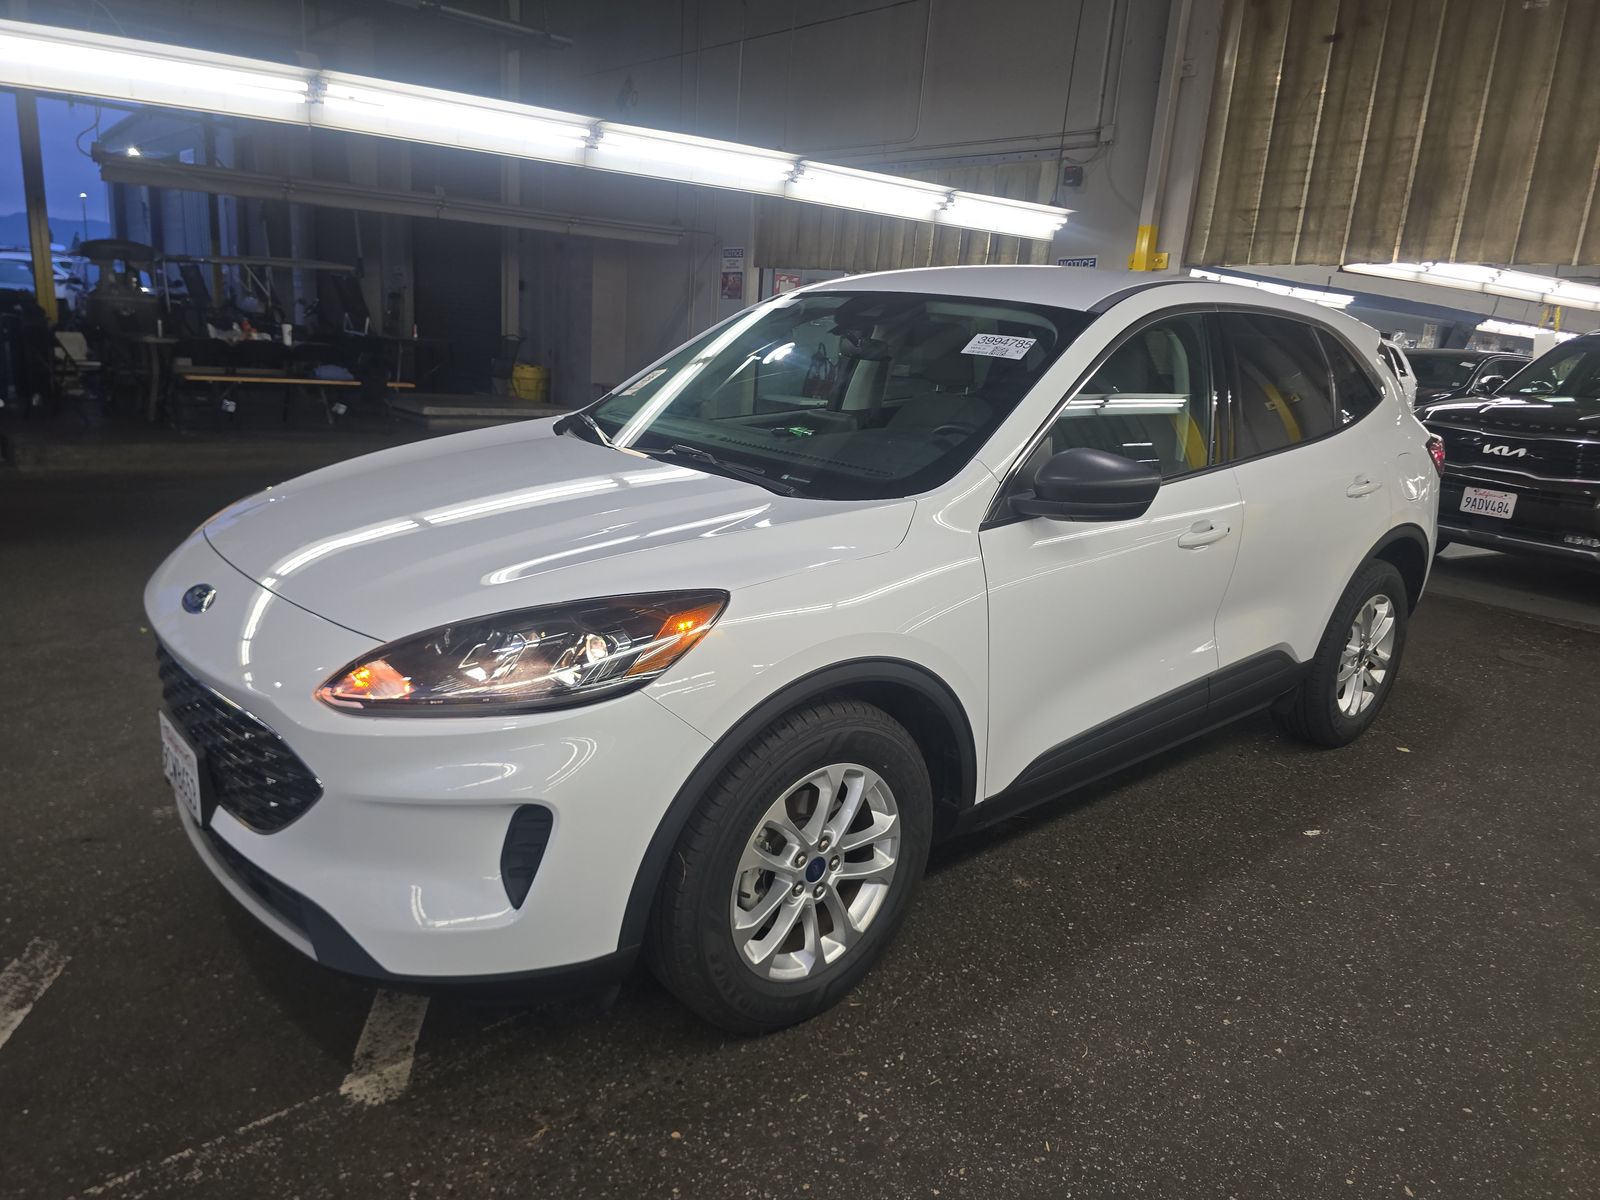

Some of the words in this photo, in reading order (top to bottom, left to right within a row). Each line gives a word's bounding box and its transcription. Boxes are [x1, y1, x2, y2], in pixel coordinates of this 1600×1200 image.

[1060, 259, 1095, 268] NOTICE
[978, 336, 1032, 349] 3994785
[1464, 497, 1509, 514] 9ADV484
